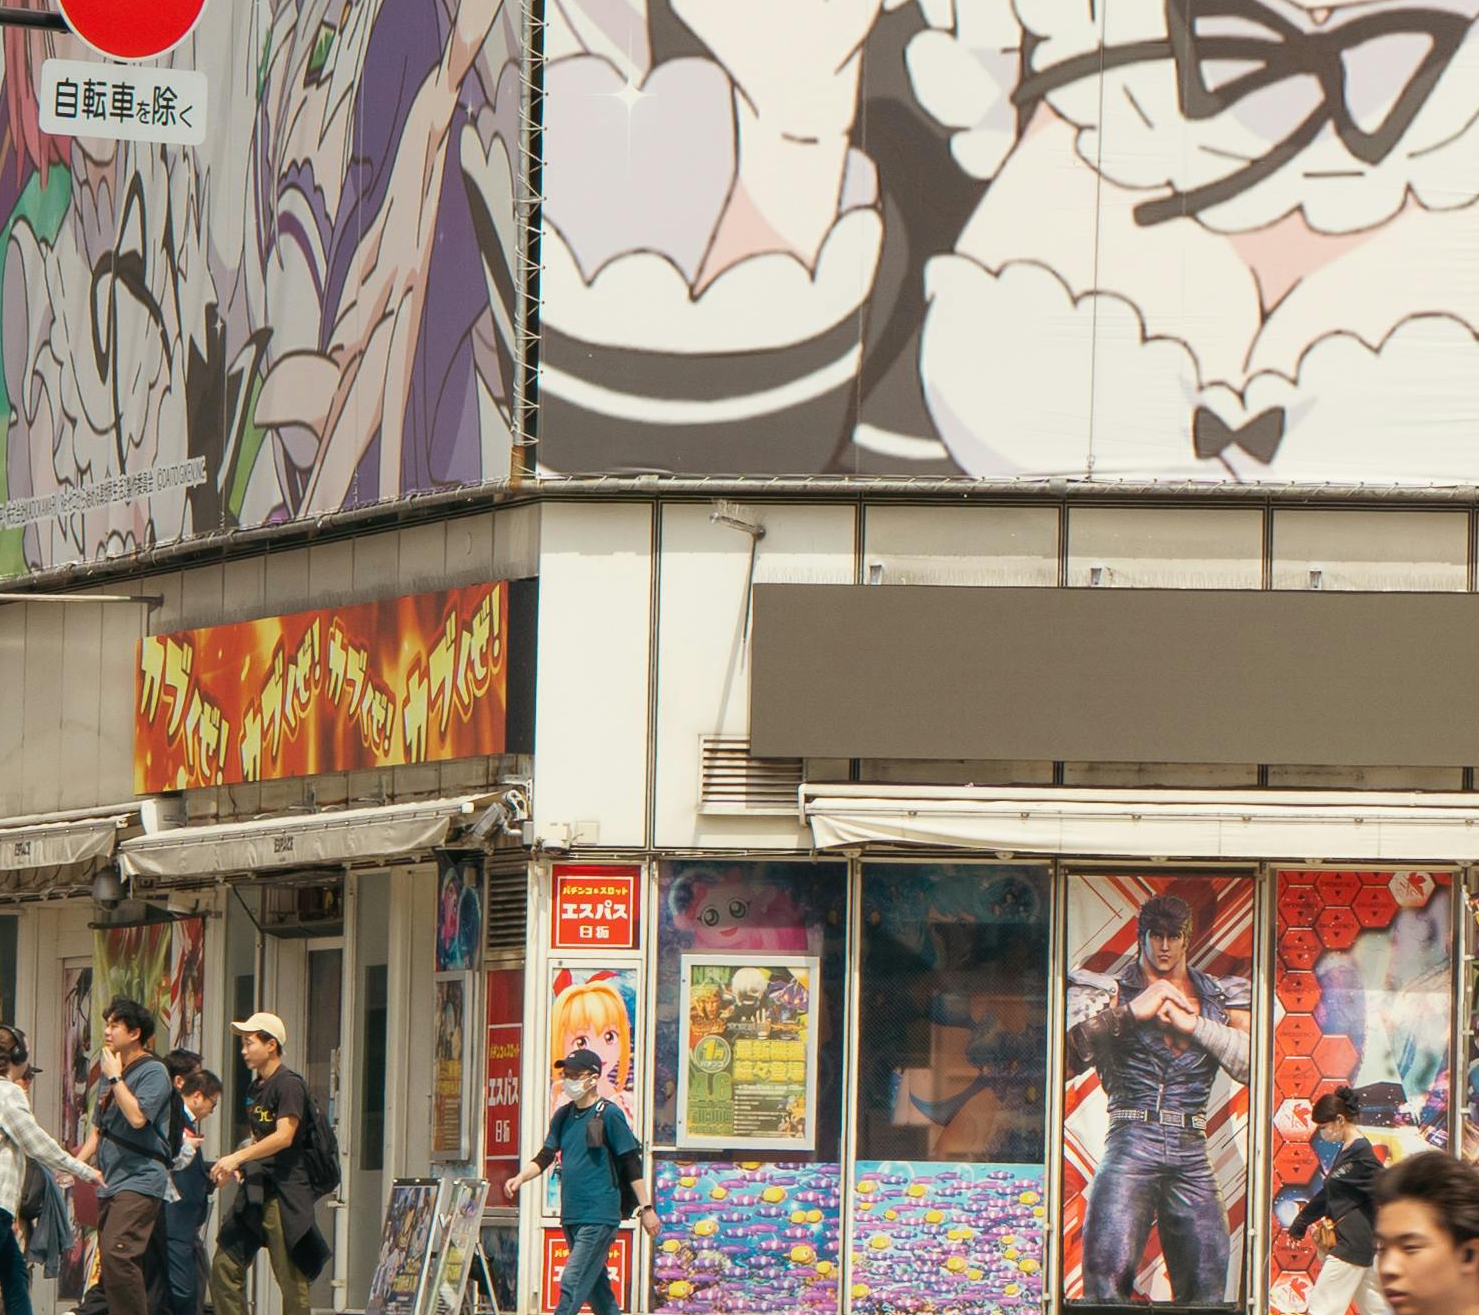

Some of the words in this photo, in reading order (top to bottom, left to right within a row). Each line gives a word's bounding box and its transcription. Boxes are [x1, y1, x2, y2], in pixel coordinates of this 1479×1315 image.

[54, 77, 194, 129] 自転車を除く
[563, 886, 628, 894] パチンコ&スロット
[562, 900, 627, 920] エスパス
[488, 1069, 519, 1107] エスパス
